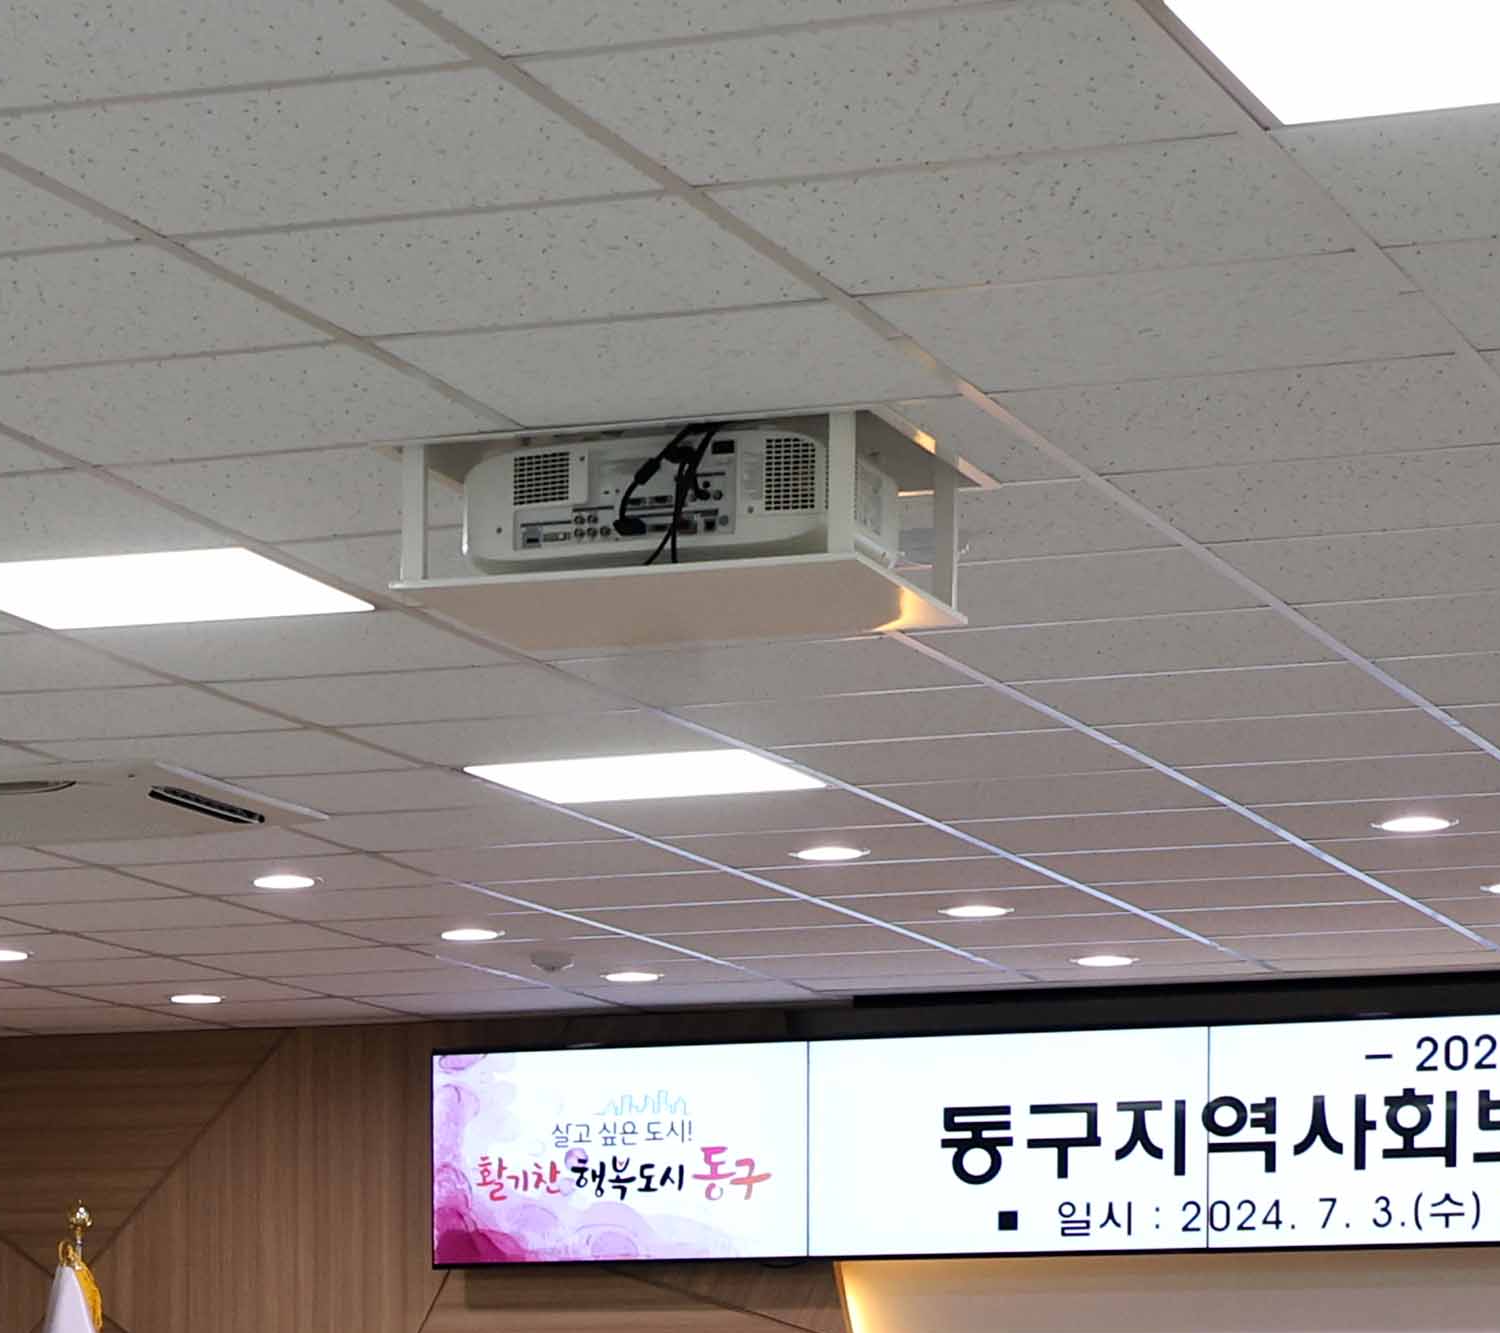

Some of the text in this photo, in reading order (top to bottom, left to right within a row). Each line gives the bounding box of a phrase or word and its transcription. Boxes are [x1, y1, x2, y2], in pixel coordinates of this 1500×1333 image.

[551, 1120, 692, 1149] 살고 싶은 도시!
[476, 1146, 772, 1201] 활기찬 행복도시 동구
[1058, 1201, 1132, 1237] 일시
[1181, 1201, 1296, 1232] 2024.
[1319, 1197, 1350, 1229] 7.
[1372, 1191, 1481, 1231] 3.(수)
